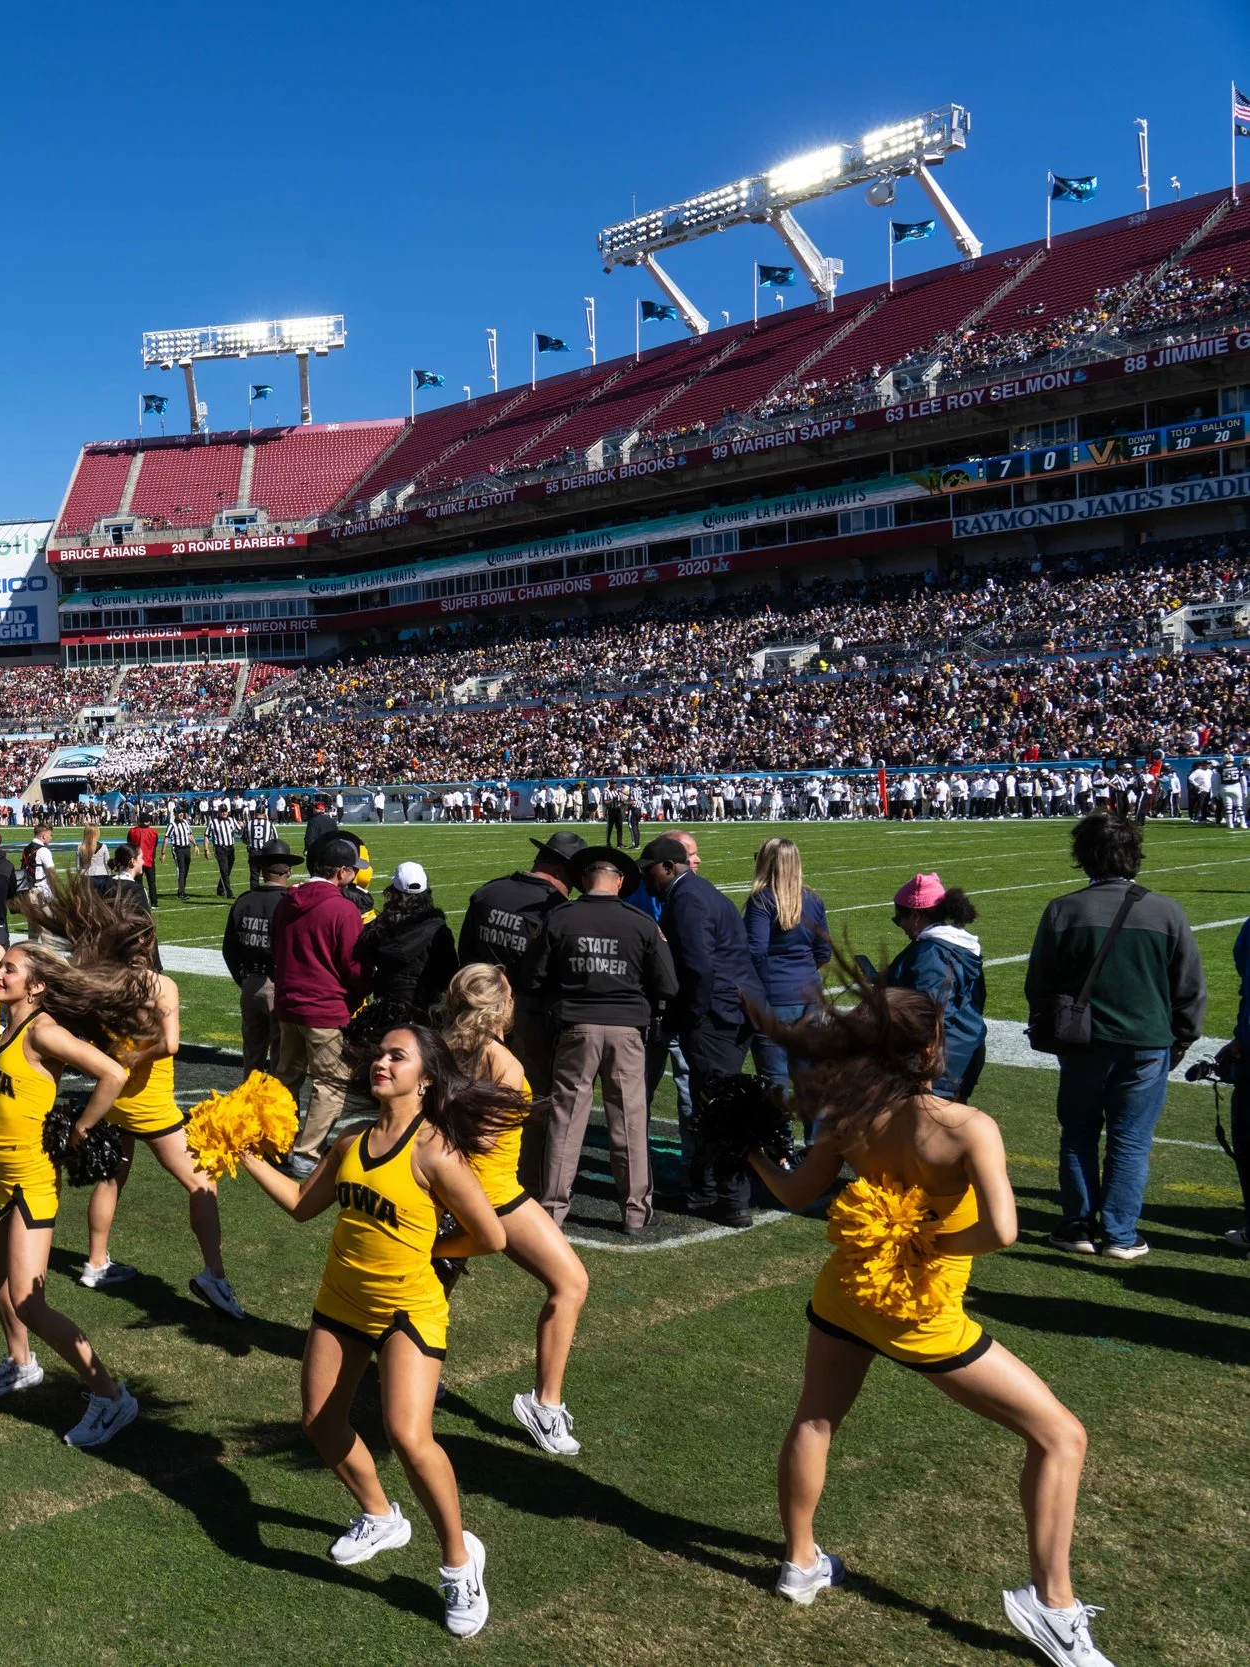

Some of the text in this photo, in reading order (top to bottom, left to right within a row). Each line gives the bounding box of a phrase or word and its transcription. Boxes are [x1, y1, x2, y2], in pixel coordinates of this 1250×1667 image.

[1128, 212, 1148, 225] 336
[959, 261, 975, 272] 337
[1124, 355, 1147, 374] 88
[1153, 336, 1229, 367] JIMMIE
[885, 371, 1070, 423] 63 LEE ROY SELMON
[1171, 426, 1197, 438] TO GO
[1202, 419, 1240, 433] BALL ON
[712, 420, 842, 460] 99 WARREN SAPP
[1128, 434, 1155, 445] DOWN
[1175, 438, 1191, 450] 10
[1214, 430, 1230, 444] 20
[1131, 444, 1151, 457] 1ST
[1000, 460, 1011, 478] 7
[1044, 452, 1056, 470] 0
[545, 456, 675, 494] 55 DERRICK BROOKS
[426, 490, 517, 519] 40 MIKE ALSTOTT
[703, 488, 868, 530] Corona LA PLAYA AWAITS
[955, 503, 1074, 537] RAYMOND
[1081, 488, 1163, 516] JAMES
[330, 515, 401, 539] 47 JOHN LYNCH
[60, 546, 147, 560] BRUCE ARIANS
[171, 537, 285, 554] 20 RONDÉ BARBER
[487, 534, 612, 567] Corona LA PLAYA AWAITS
[677, 561, 710, 577] 2020
[310, 569, 417, 594] Corona LA PLAYA AWAITS
[609, 571, 639, 587] 2002
[92, 590, 224, 607] Corona LA PLAYA AWAITS
[441, 578, 592, 612] SUPER BOWL CHAMPIONS
[106, 627, 182, 640] JON GRUDEN
[225, 619, 318, 635] 97 SIMEON RICE
[253, 825, 264, 839] B
[241, 917, 269, 932] STATE
[488, 909, 524, 931] STATE
[239, 931, 271, 949] TROOPE
[479, 925, 527, 952] TROOPER
[577, 937, 619, 955] STATE
[569, 957, 628, 975] TROOPER
[336, 1181, 399, 1231] OWA
